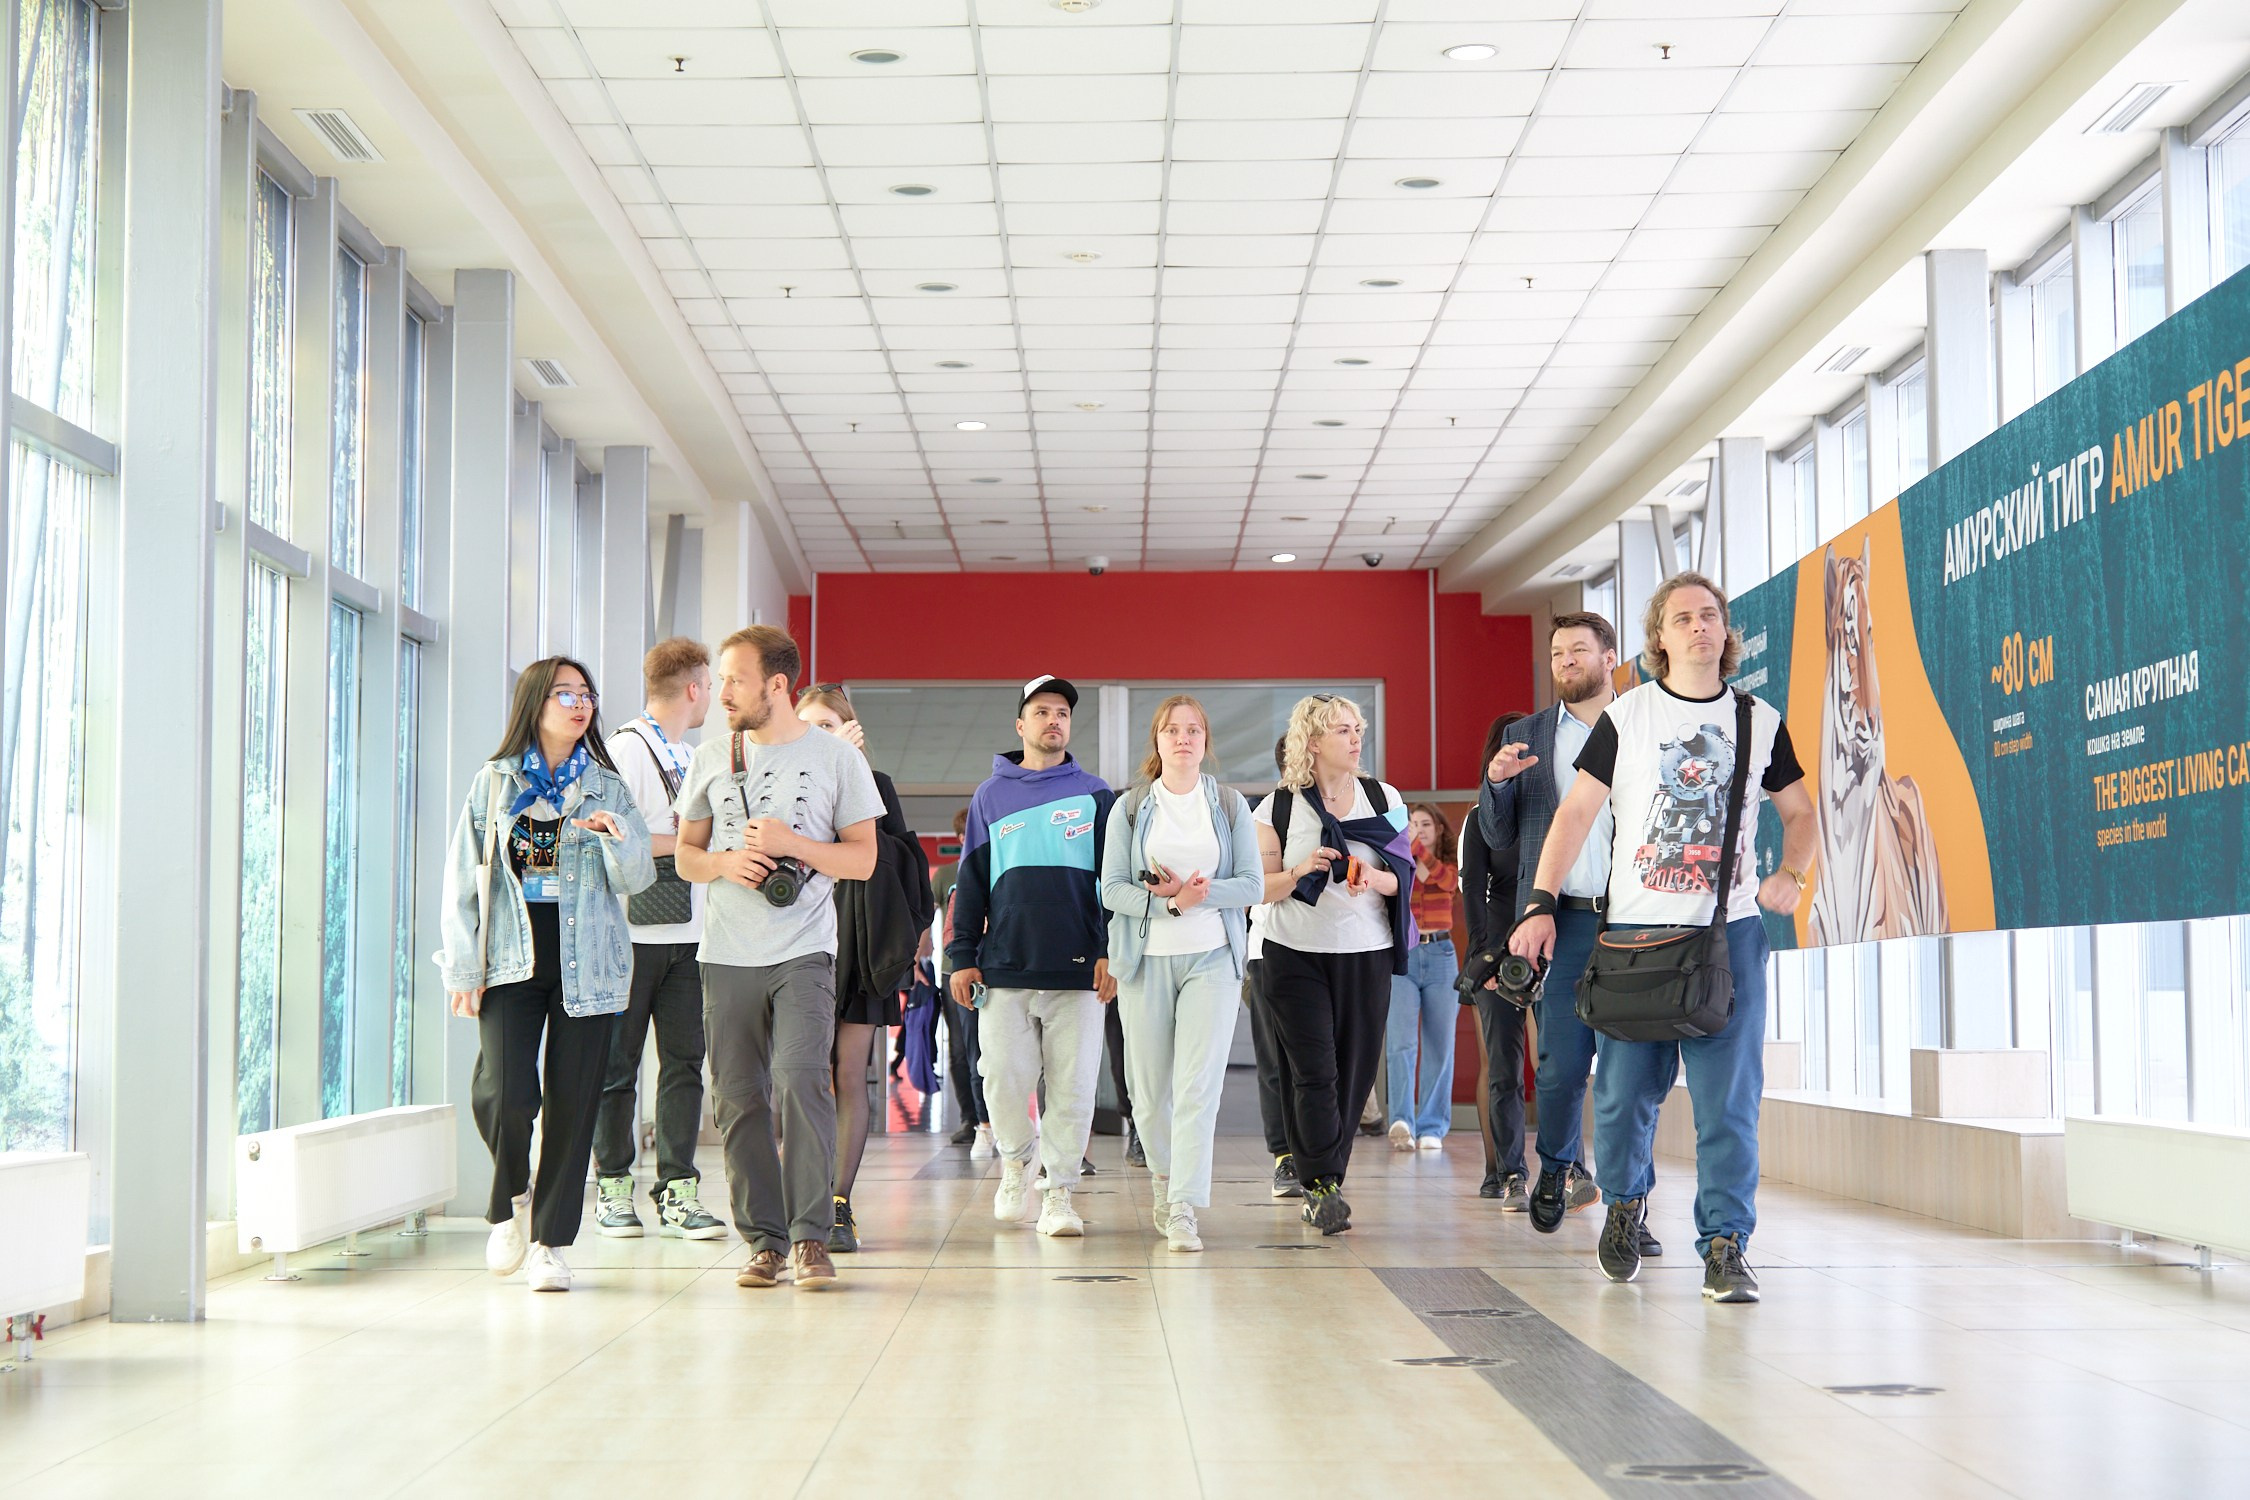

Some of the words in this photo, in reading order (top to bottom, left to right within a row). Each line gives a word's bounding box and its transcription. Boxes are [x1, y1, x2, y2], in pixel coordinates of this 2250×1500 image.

[2110, 400, 2184, 505] AMUR
[2187, 356, 2250, 461] TIGE
[1943, 461, 2045, 587] АМУРСКИЙ
[2048, 444, 2105, 533] ТИГР
[1991, 631, 2024, 696] ~80
[2086, 671, 2130, 722] САМАЯ
[2132, 649, 2199, 708] КРУПНАЯ
[2087, 734, 2110, 757] кошка
[2110, 731, 2121, 751] на
[2121, 724, 2146, 748] земле
[2093, 772, 2119, 812] THE
[2120, 759, 2175, 808] BIGGEST
[2177, 747, 2225, 797] LIVING
[2097, 821, 2124, 853] species
[2124, 819, 2132, 843] in
[2132, 816, 2145, 842] the
[2145, 811, 2168, 840] world
